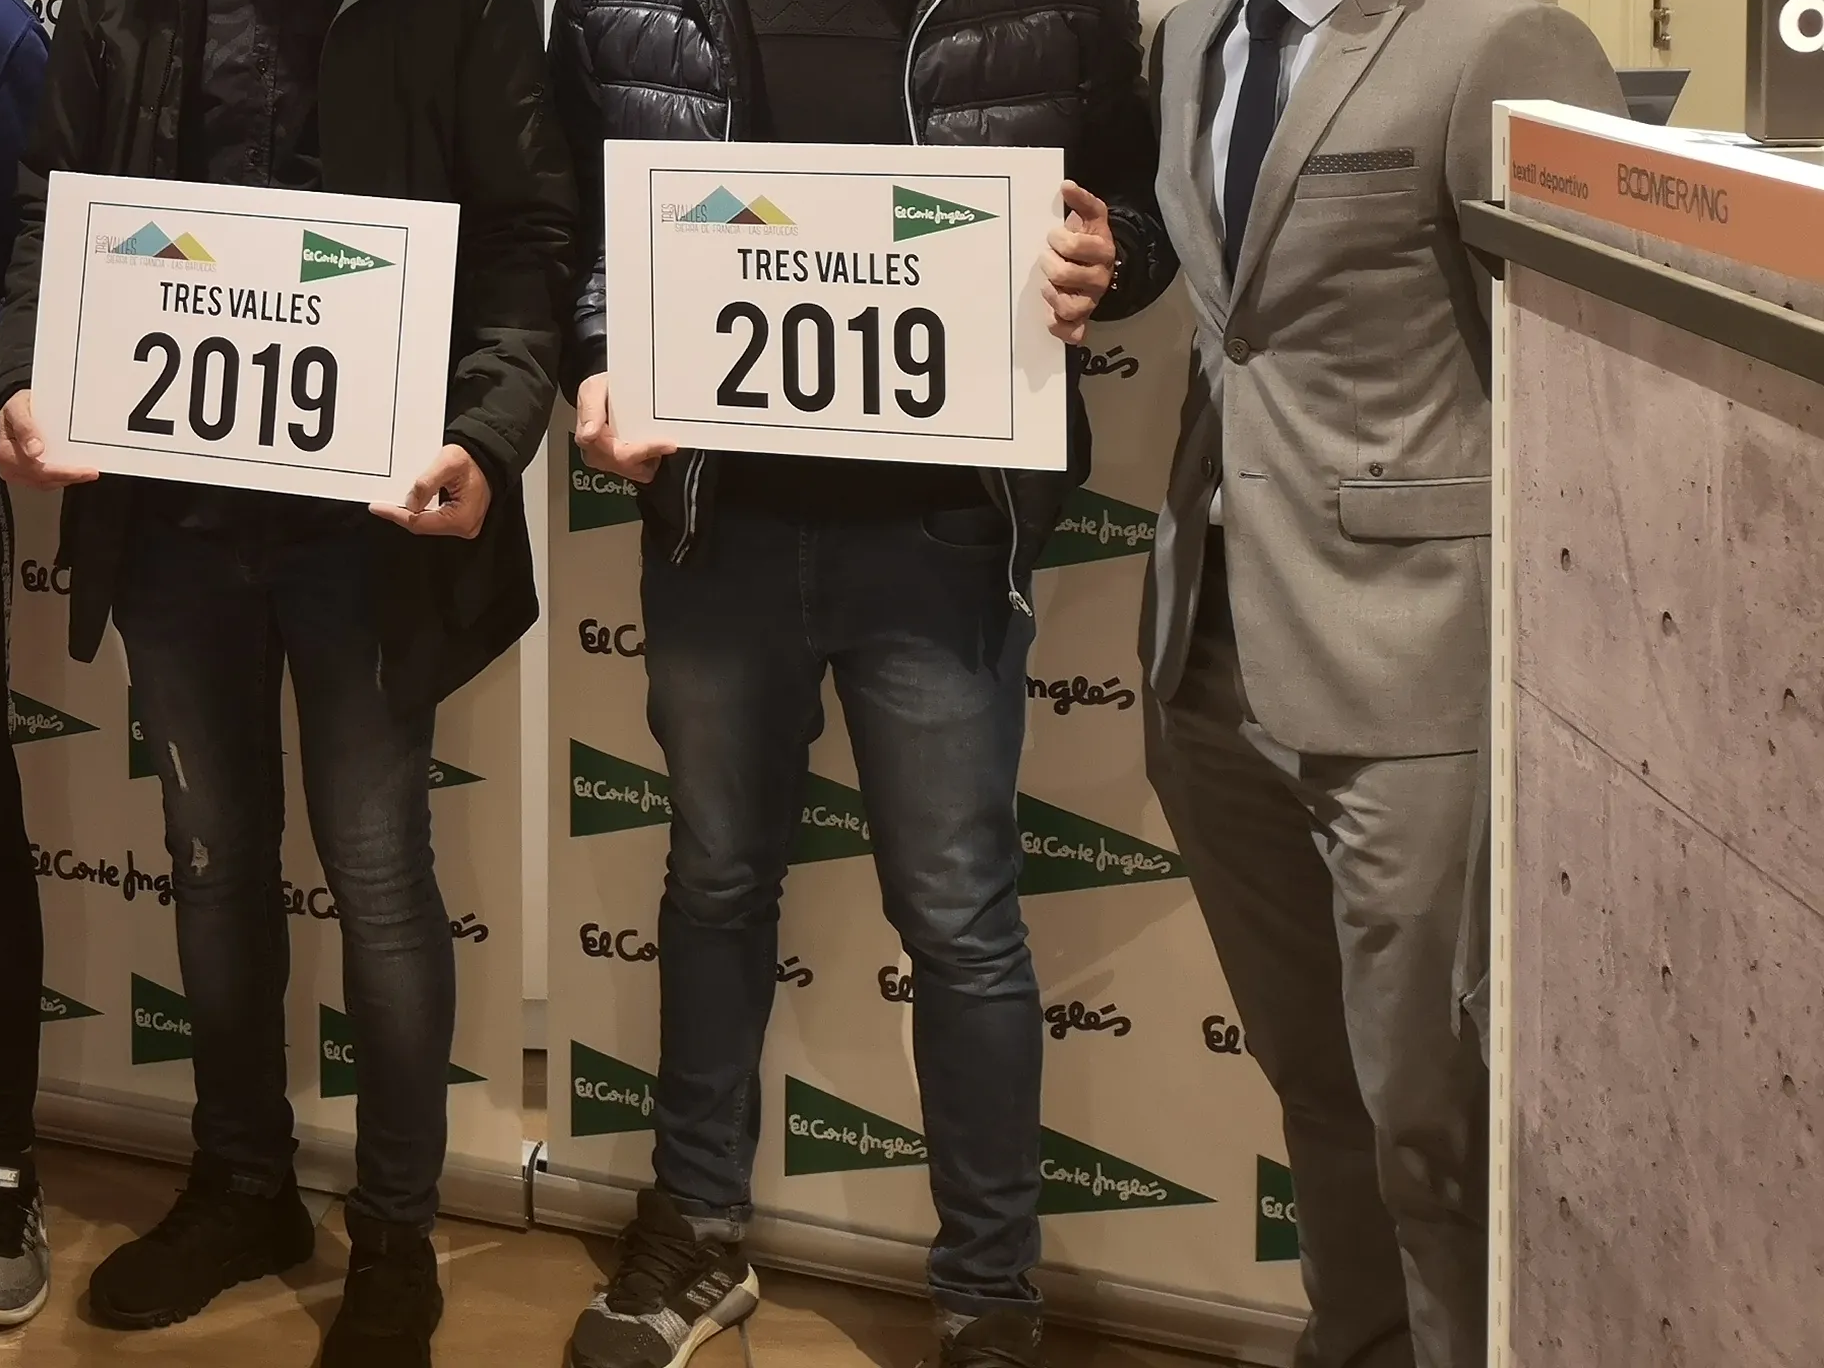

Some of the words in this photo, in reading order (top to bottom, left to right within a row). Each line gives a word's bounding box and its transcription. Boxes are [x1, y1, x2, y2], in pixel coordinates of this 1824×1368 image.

[1512, 160, 1537, 180] textil
[1539, 170, 1589, 200] deportivo
[1617, 162, 1728, 224] BOOMERANG
[674, 203, 708, 223] VALLES
[748, 226, 762, 235] LAS
[895, 205, 906, 219] El
[907, 207, 934, 221] Corte
[934, 203, 975, 224] Inglés
[304, 249, 314, 261] El
[314, 251, 338, 264] Corte
[337, 249, 374, 269] Inglés
[738, 249, 808, 282] TRES
[815, 251, 920, 286] VALLES
[160, 282, 222, 316] TRES
[229, 288, 322, 325] VALLES
[716, 301, 946, 418] 2019
[127, 332, 338, 452] 2019
[572, 469, 591, 495] El
[591, 471, 637, 498] Corte
[54, 849, 119, 887] Corte
[1020, 832, 1042, 854] El
[1043, 836, 1093, 862] Corte
[1096, 838, 1171, 876] Inglés
[788, 1114, 808, 1136] El
[810, 1118, 857, 1146] Corte
[1039, 1159, 1090, 1187] Corte
[1092, 1163, 1167, 1201] Inglés
